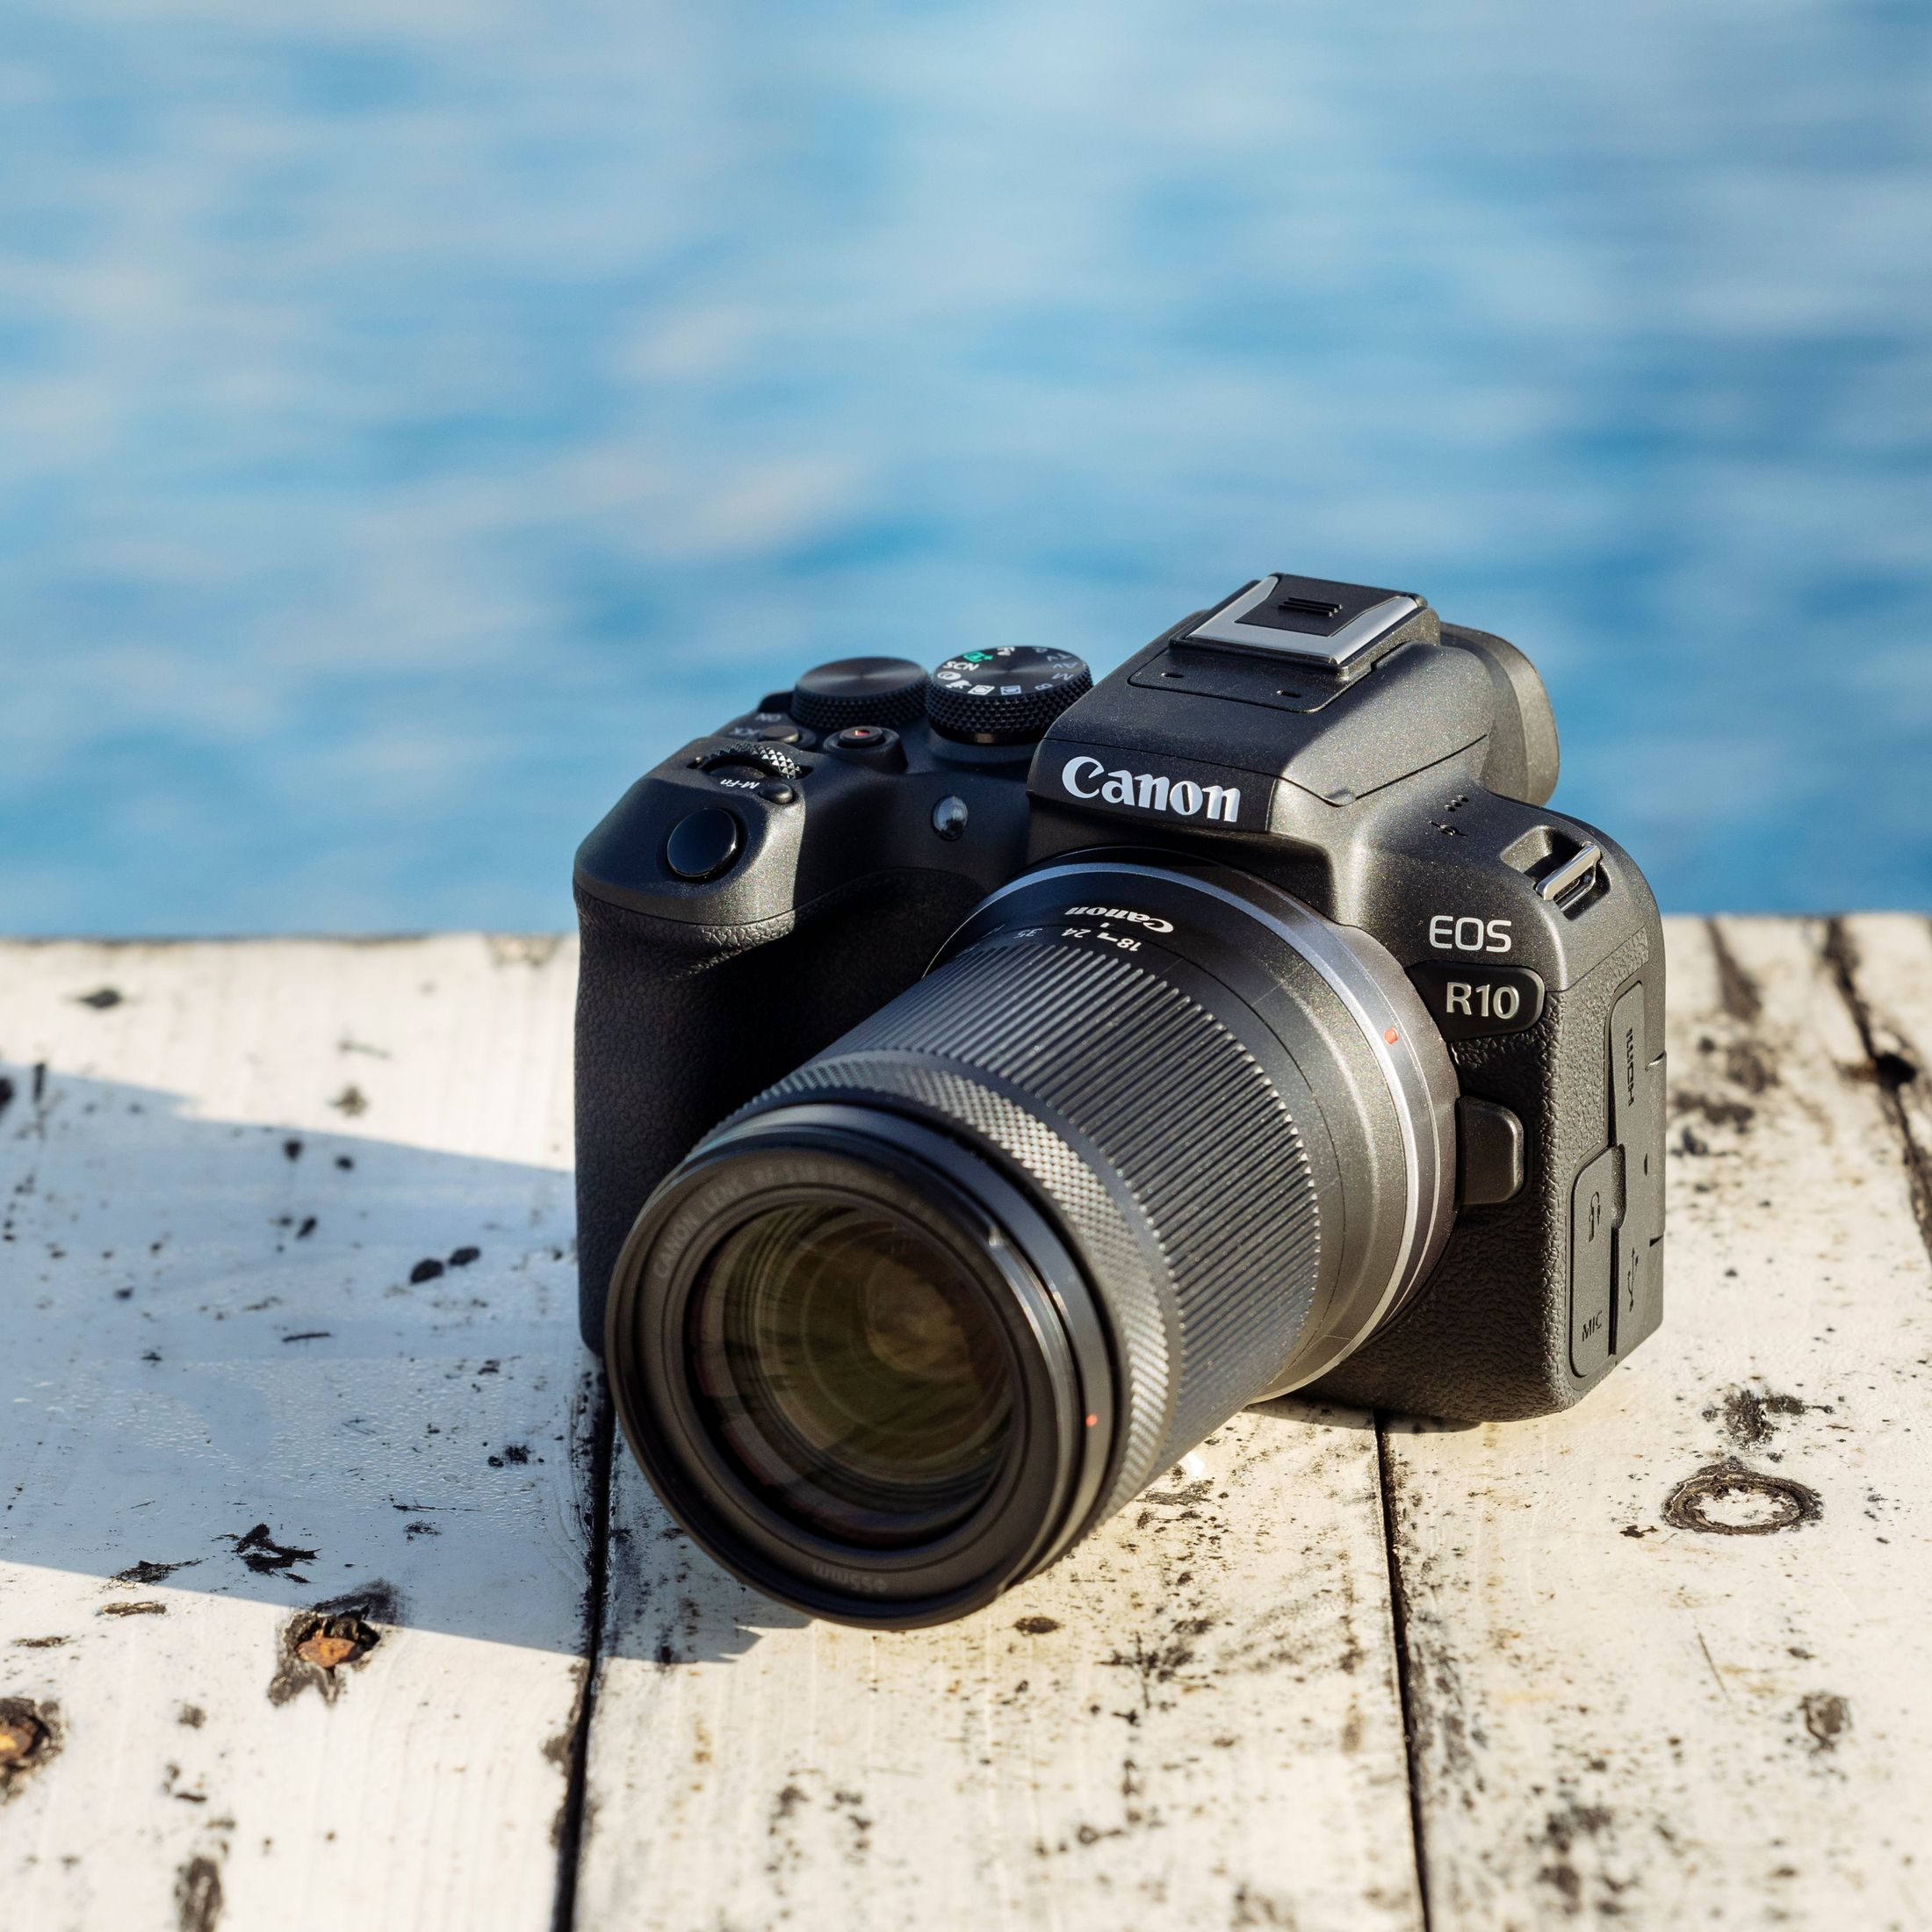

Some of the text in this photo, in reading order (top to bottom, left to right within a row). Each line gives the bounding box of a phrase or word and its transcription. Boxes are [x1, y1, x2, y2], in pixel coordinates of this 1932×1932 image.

[942, 660, 980, 672] SCN
[720, 779, 761, 789] M-Fn
[1062, 756, 1241, 823] Canon
[1064, 906, 1174, 934] Canon
[1429, 915, 1512, 953] EOS
[1013, 927, 1142, 952] 18 24 35
[1445, 982, 1520, 1020] R10
[1582, 1309, 1603, 1343] MIC
